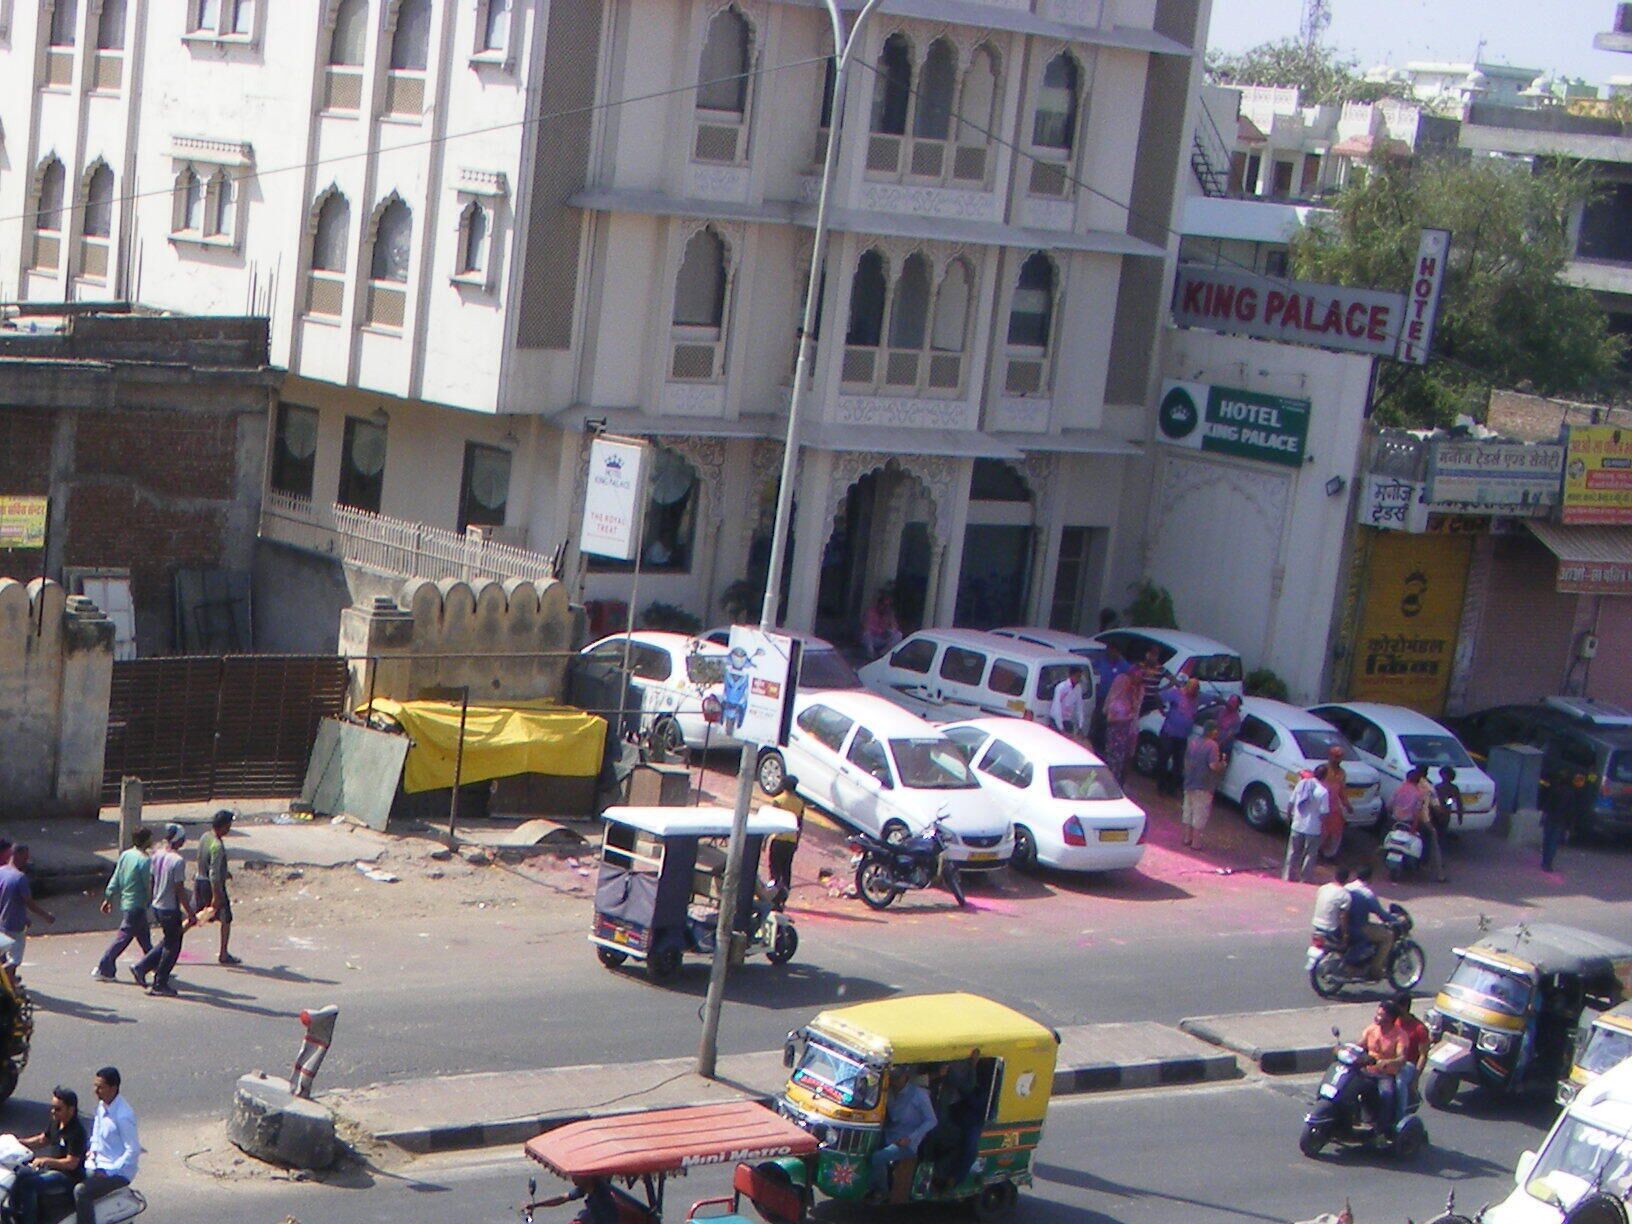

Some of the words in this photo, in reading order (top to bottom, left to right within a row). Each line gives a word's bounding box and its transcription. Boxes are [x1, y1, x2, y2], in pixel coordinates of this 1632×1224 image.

[1182, 279, 1258, 323] KING
[1265, 291, 1390, 342] PALACE
[1404, 256, 1436, 361] HOTEL
[1220, 400, 1282, 428] HOTEL
[1240, 427, 1299, 453] PALACE
[1374, 479, 1416, 502] मनोज
[591, 512, 603, 522] THE
[604, 514, 625, 525] ROYAL
[597, 524, 618, 535] TREAT
[680, 1150, 726, 1168] Mini
[729, 1145, 792, 1162] Metro
